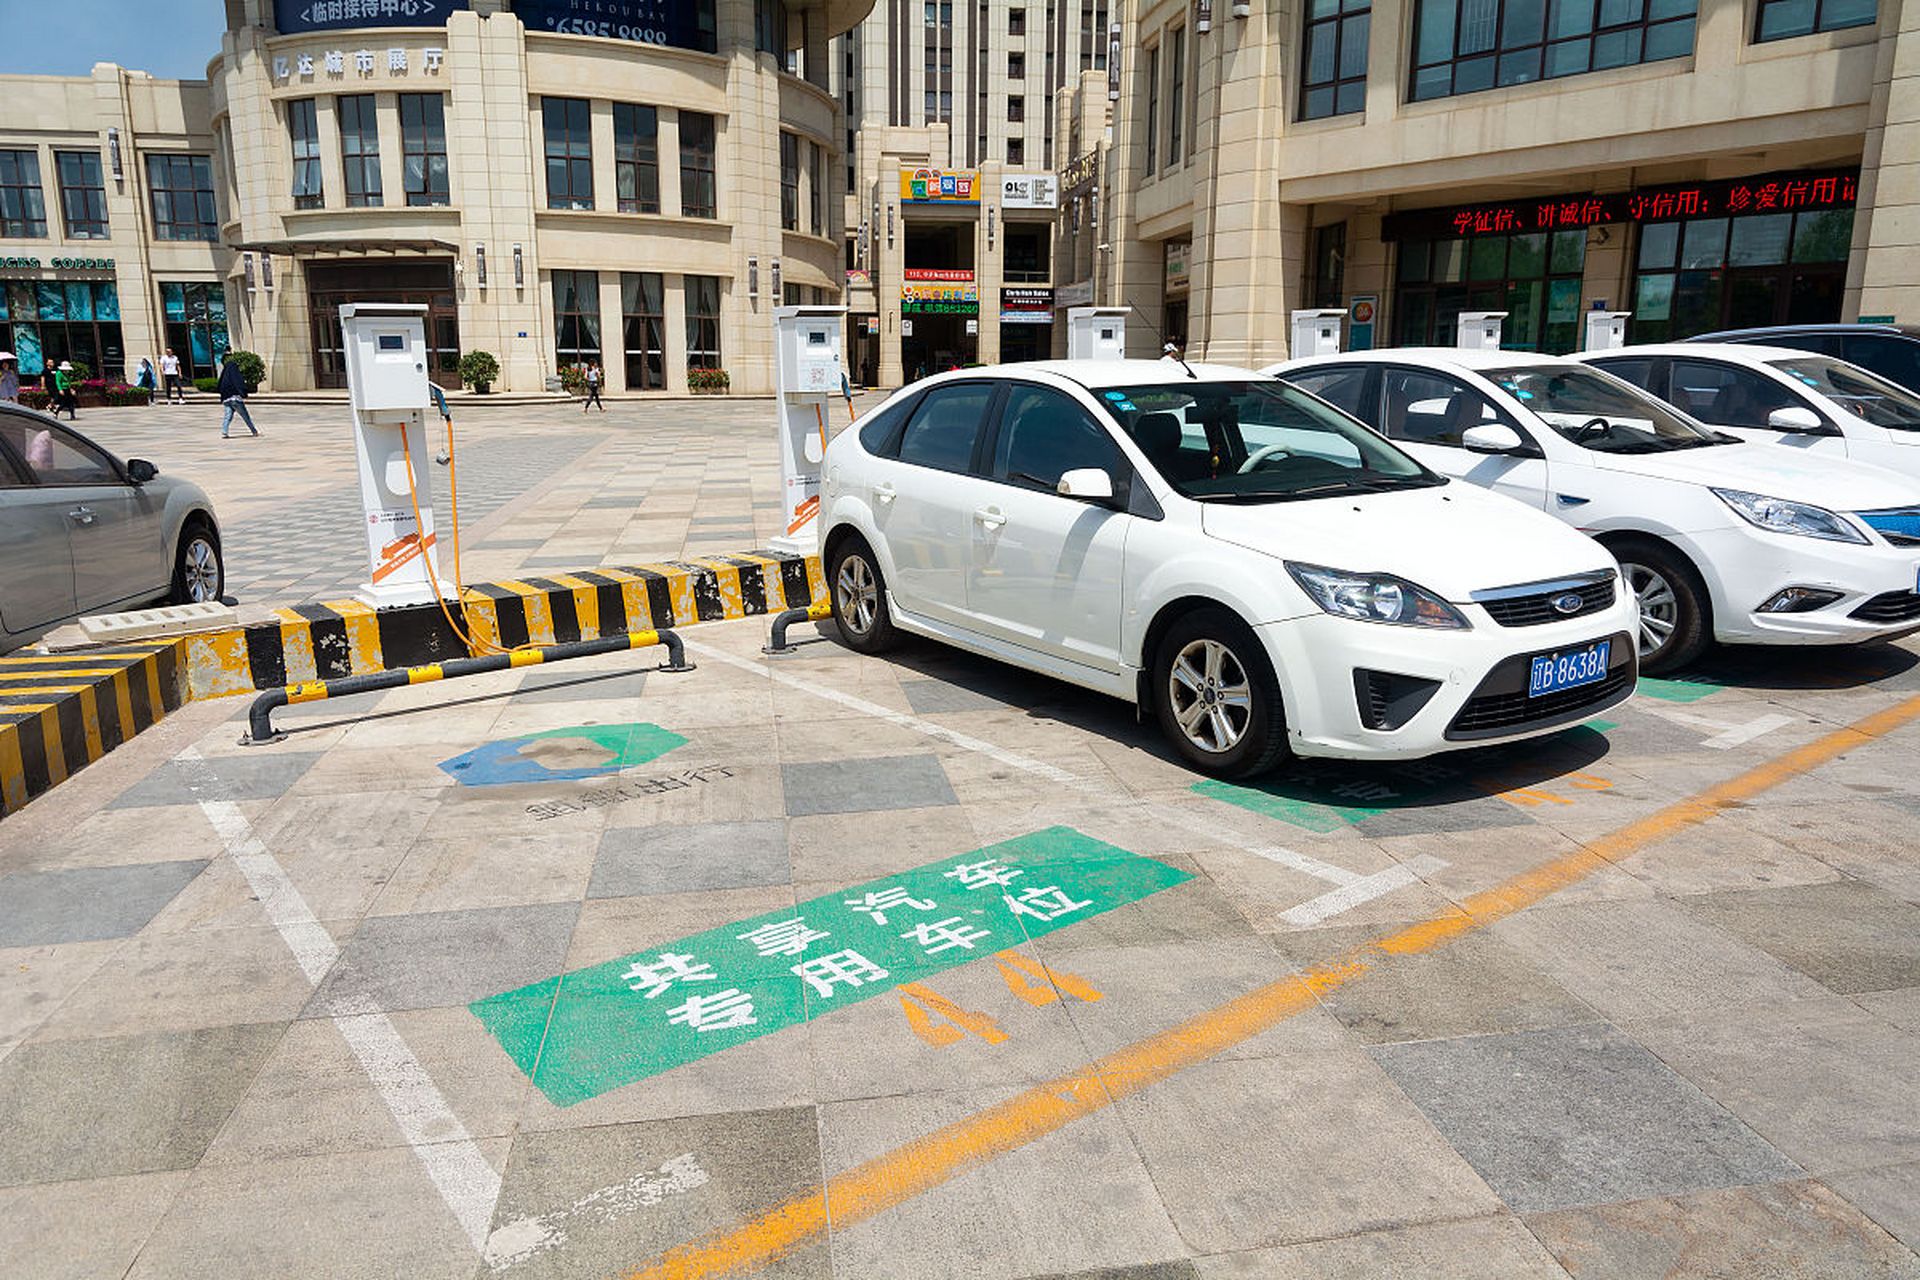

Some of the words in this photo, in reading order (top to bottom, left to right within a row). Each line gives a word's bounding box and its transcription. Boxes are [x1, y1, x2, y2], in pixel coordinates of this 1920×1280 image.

[272, 46, 444, 79] 亿达城市展厅
[0, 257, 38, 269] CKS
[51, 257, 115, 269] COFFEE
[620, 858, 1024, 999] 共享汽车
[665, 885, 1094, 1032] 专用车位
[899, 948, 1104, 1050] 44
